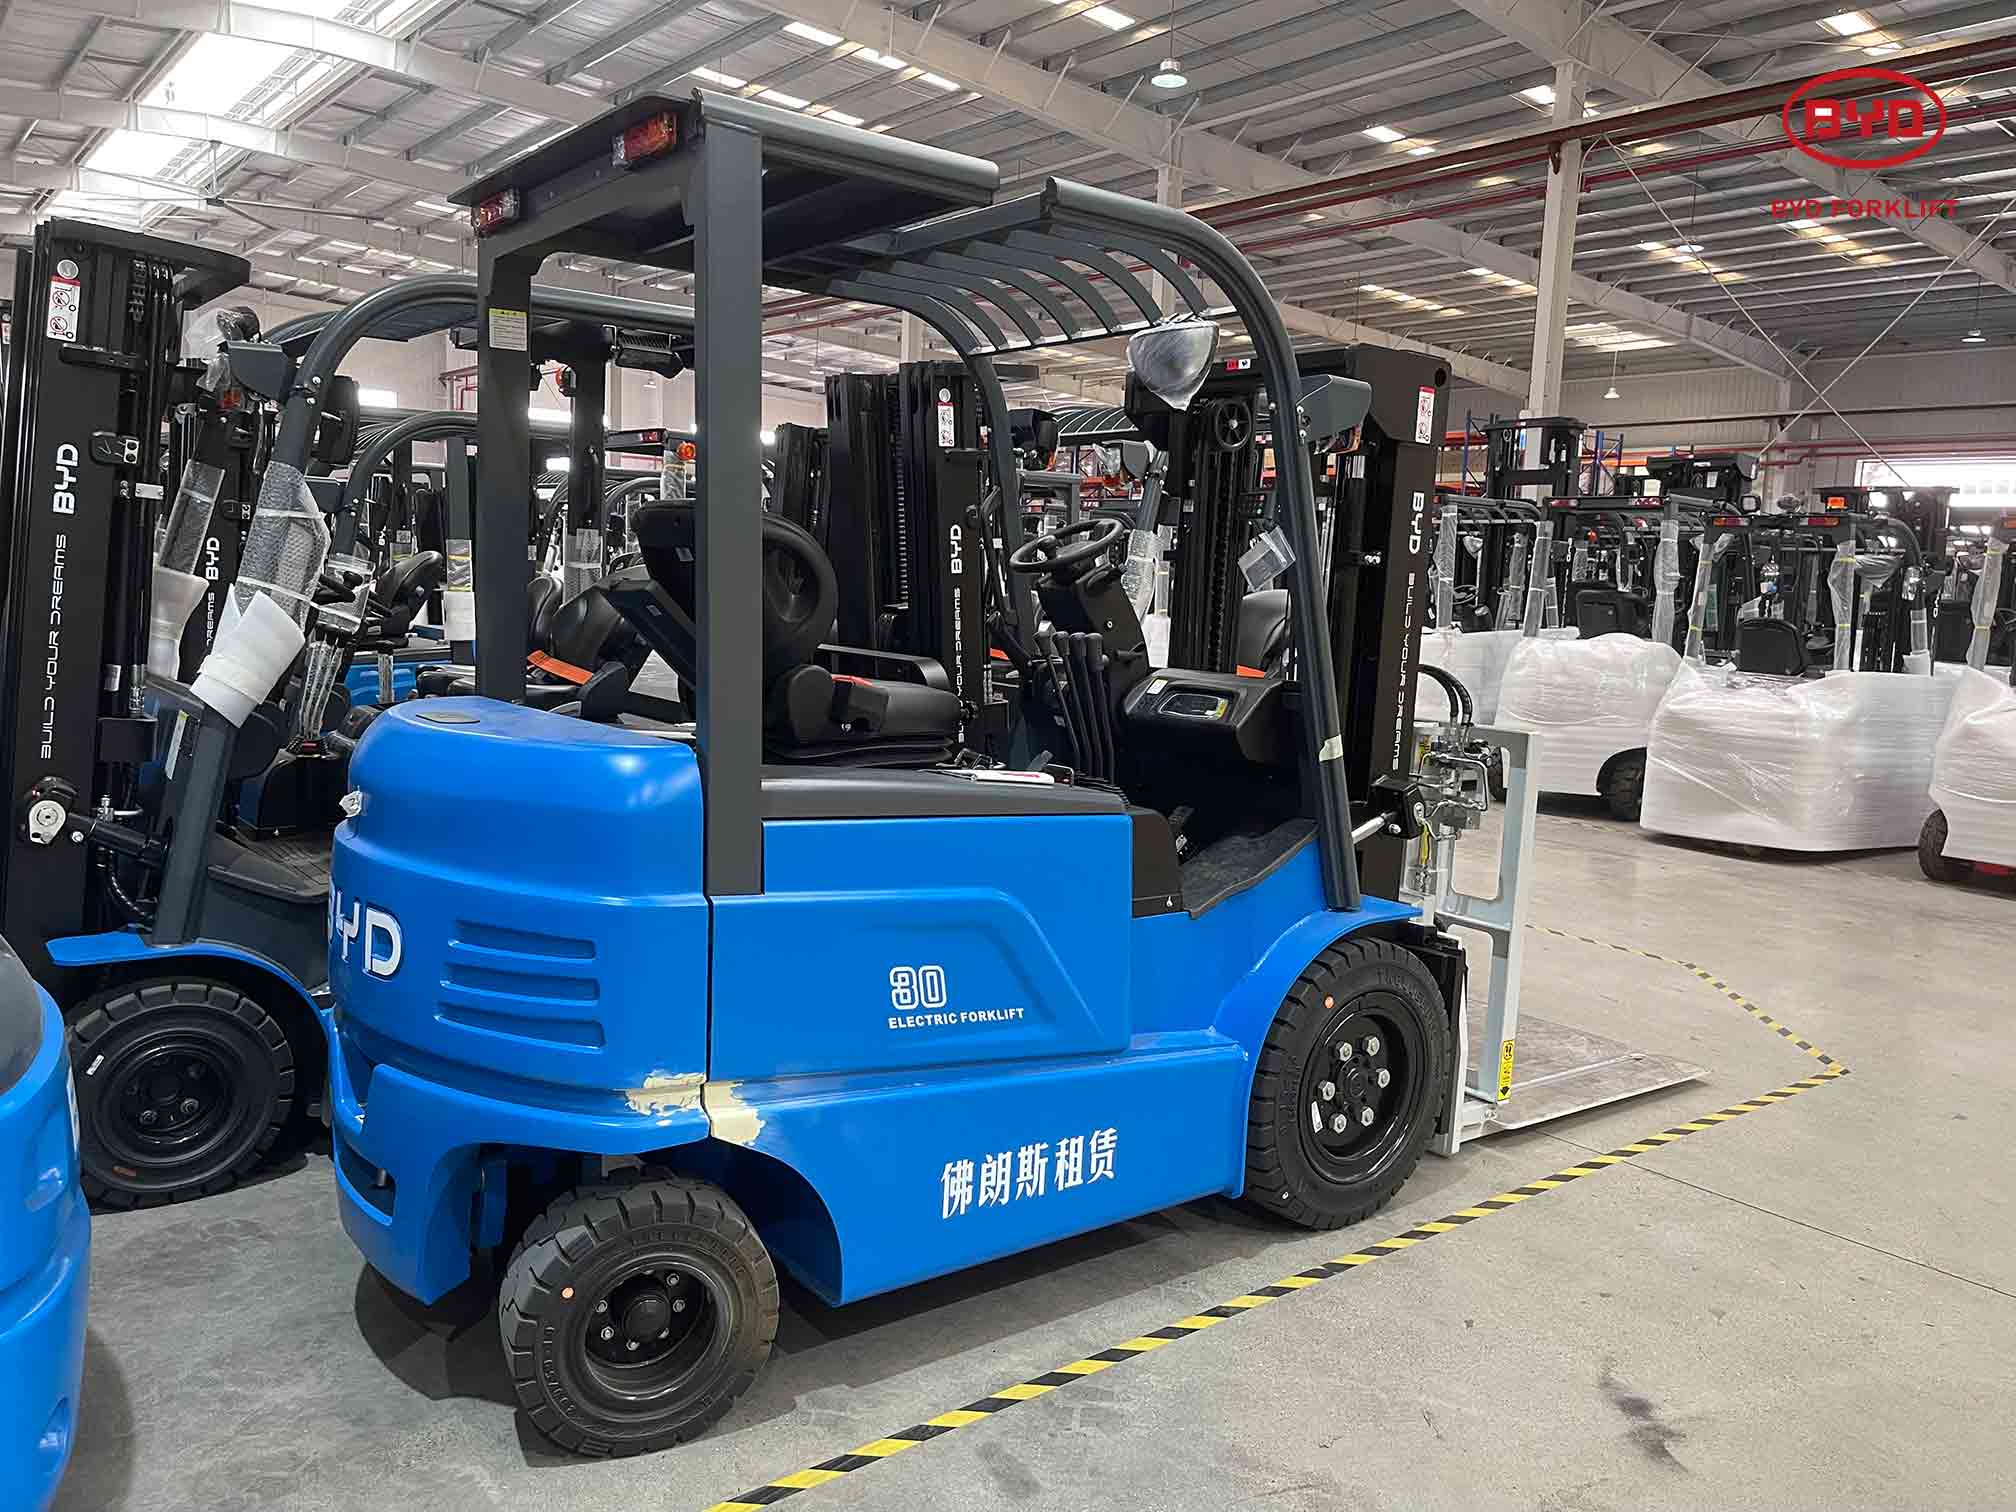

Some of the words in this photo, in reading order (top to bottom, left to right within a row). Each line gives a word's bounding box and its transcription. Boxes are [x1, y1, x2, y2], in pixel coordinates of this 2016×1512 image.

[53, 443, 79, 515] BYD
[950, 524, 963, 574] BYD
[1408, 491, 1425, 555] BYD
[50, 533, 67, 625] DREAMS
[205, 536, 221, 581] BYD
[954, 587, 962, 652] DREAMS
[1404, 572, 1416, 629] BUILD
[45, 630, 60, 691] YOUR
[1399, 633, 1410, 687] YOUR
[40, 696, 56, 760] BUILD
[1392, 690, 1406, 771] DREAMS
[887, 1012, 958, 1030] ELECTRIC
[960, 1007, 1025, 1024] FORKLIFT
[940, 1127, 1119, 1220] 佛朗斯租赁
